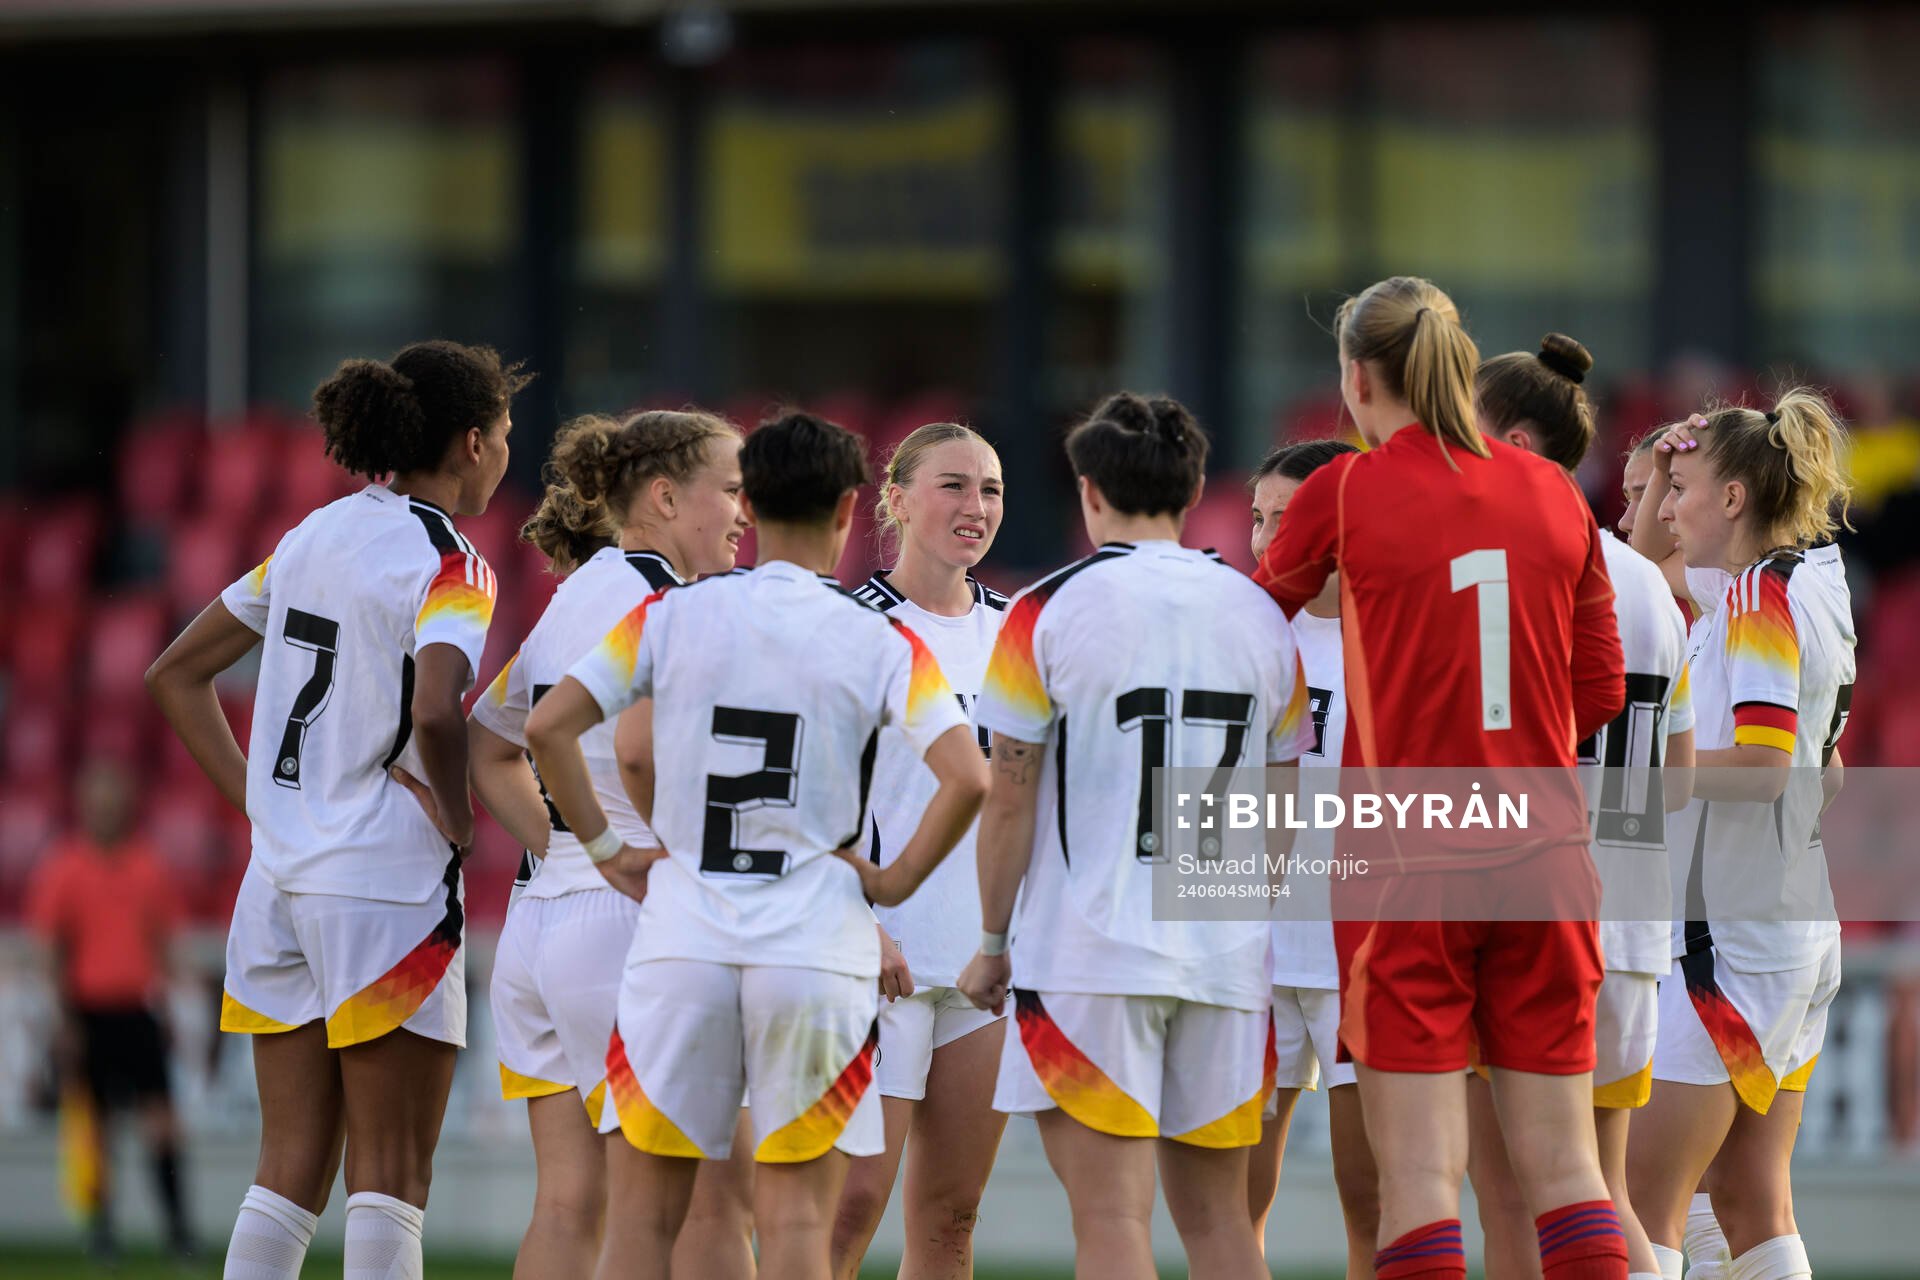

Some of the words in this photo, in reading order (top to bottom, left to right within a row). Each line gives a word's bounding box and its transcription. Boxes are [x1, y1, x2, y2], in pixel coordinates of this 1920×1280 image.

[271, 607, 340, 790] 7
[1450, 549, 1511, 731] 1
[700, 705, 805, 882] 2
[1116, 687, 1257, 865] 17
